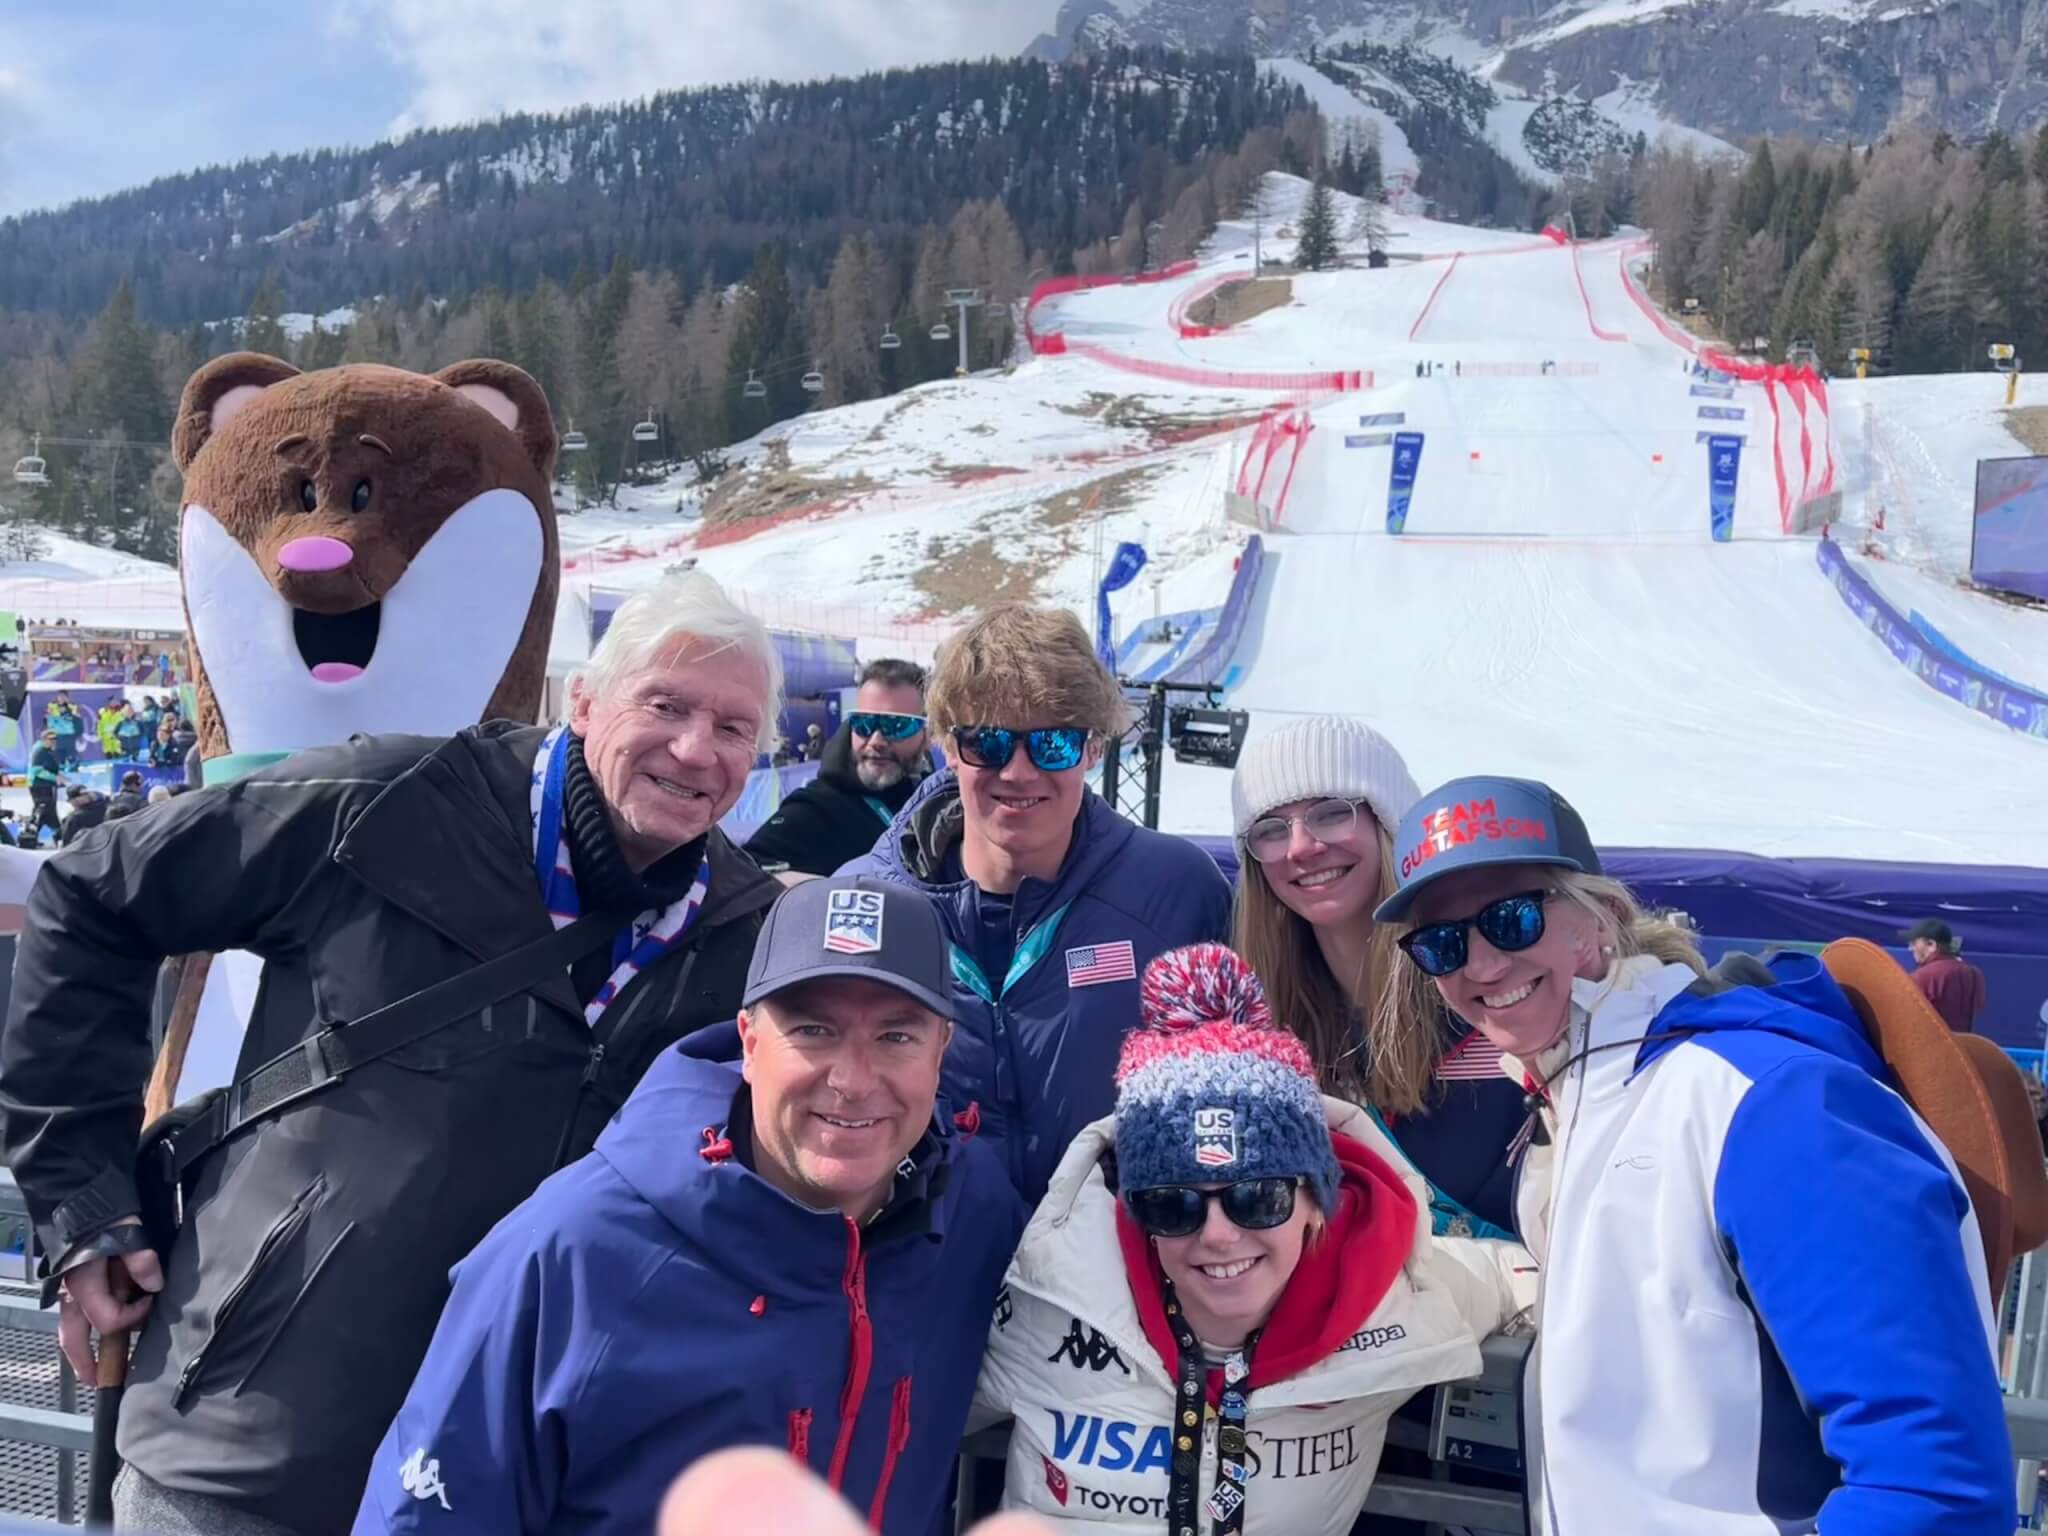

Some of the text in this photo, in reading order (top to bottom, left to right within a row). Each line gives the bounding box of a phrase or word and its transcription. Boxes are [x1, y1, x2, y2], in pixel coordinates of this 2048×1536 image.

[1422, 798, 1496, 835] TEAM
[1402, 816, 1546, 878] GUSTAFSON
[832, 893, 881, 912] US
[1199, 1113, 1231, 1128] US
[1333, 1324, 1406, 1352] appa
[1043, 1408, 1174, 1476] VISA
[1245, 1425, 1360, 1479] STIFEL
[1448, 1442, 1473, 1459] A 2
[1220, 1482, 1242, 1505] US
